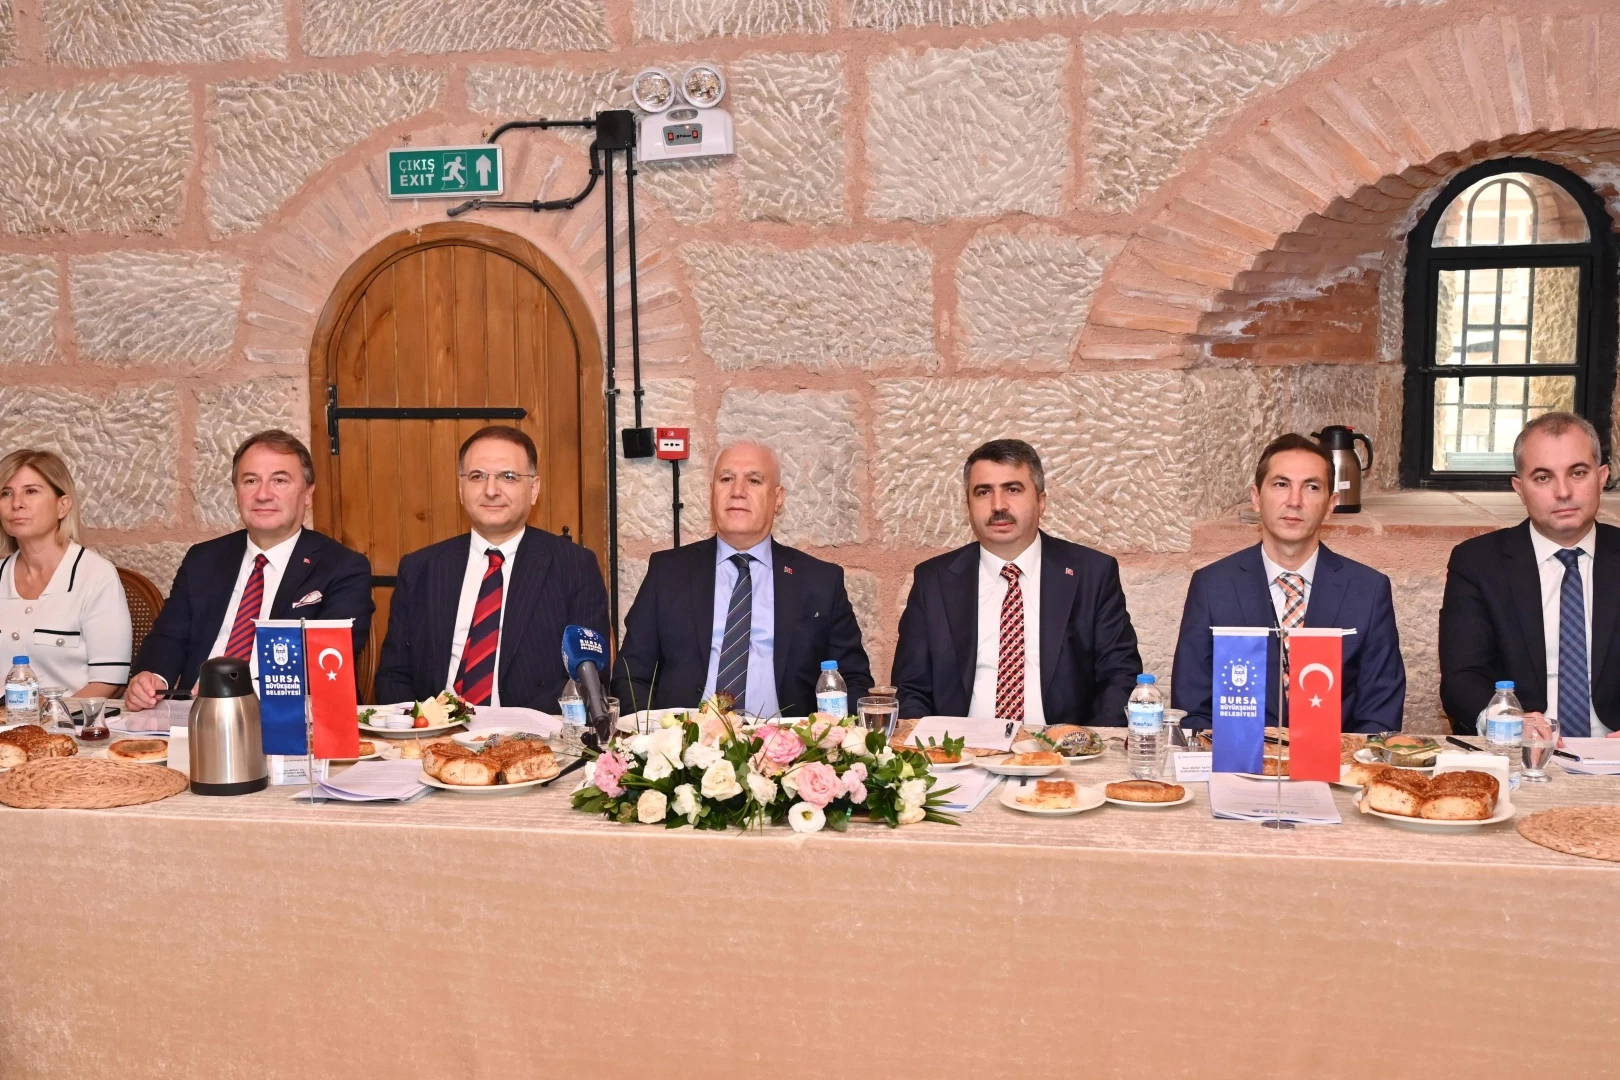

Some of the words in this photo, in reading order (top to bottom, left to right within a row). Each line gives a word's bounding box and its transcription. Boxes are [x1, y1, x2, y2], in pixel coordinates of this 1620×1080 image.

[399, 159, 435, 173] ÇIKIŞ
[400, 173, 434, 186] EXIT
[265, 675, 300, 683] BURSA
[1220, 696, 1257, 705] BURSA
